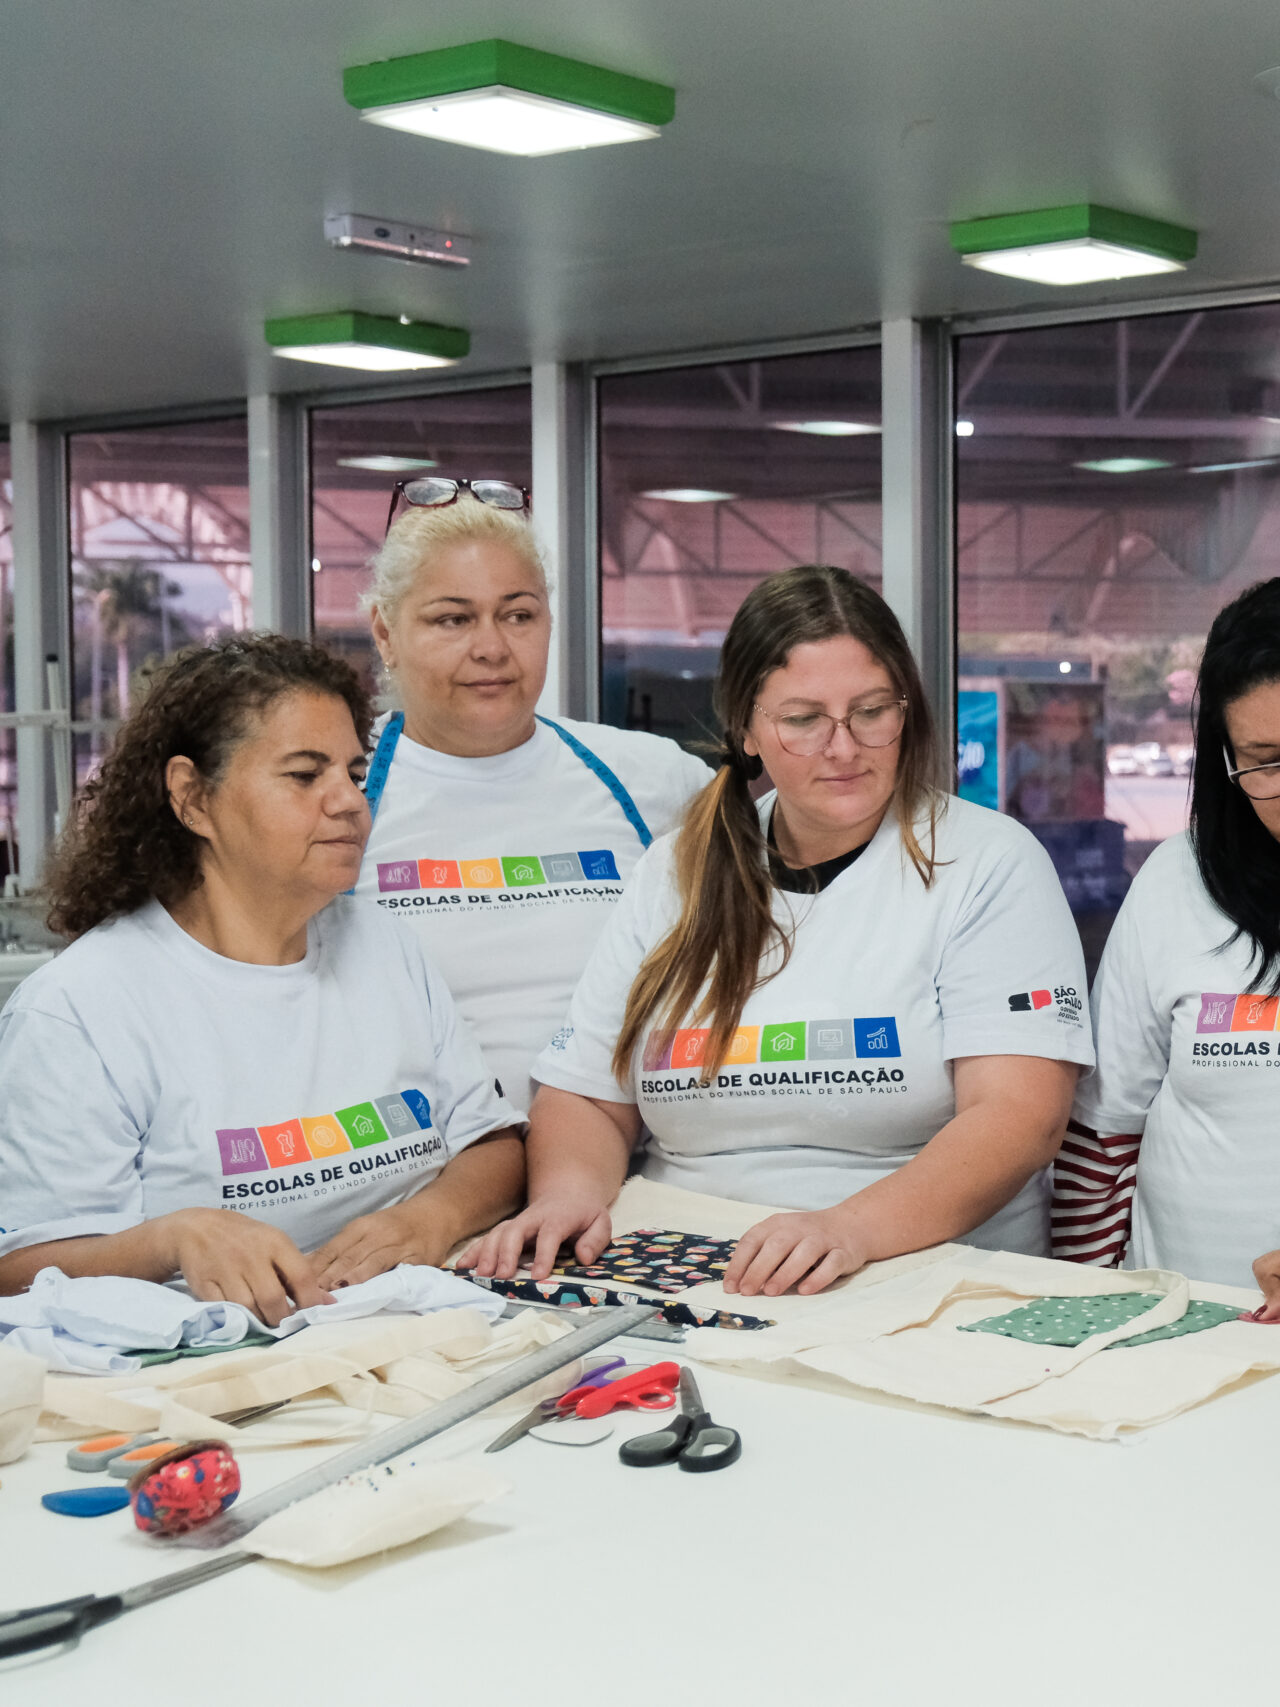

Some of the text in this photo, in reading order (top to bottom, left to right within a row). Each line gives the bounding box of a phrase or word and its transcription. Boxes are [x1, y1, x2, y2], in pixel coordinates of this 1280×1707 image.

[377, 895, 461, 909] ESCOLAS
[468, 895, 492, 904] DE
[1054, 985, 1076, 998] SÃO
[1193, 1042, 1270, 1056] ESCOLAS
[1192, 1060, 1260, 1068] PROFISSIONAL
[1266, 1060, 1280, 1068] DO
[642, 1067, 904, 1093] ESCOLAS DE QUALIFICAÇÃO
[729, 1089, 765, 1097] FUNDO
[772, 1088, 812, 1096] SOCIAL
[840, 1086, 863, 1095] SÃO
[870, 1085, 907, 1094] PAULO
[223, 1136, 442, 1199] ESCOLAS DE QUALIFICAÇÃO
[221, 1194, 308, 1211] PROFISSIONAL
[314, 1188, 327, 1197] DO
[332, 1177, 367, 1192] FUNDO
[371, 1167, 404, 1181] SOCIAL
[409, 1162, 419, 1170] DE
